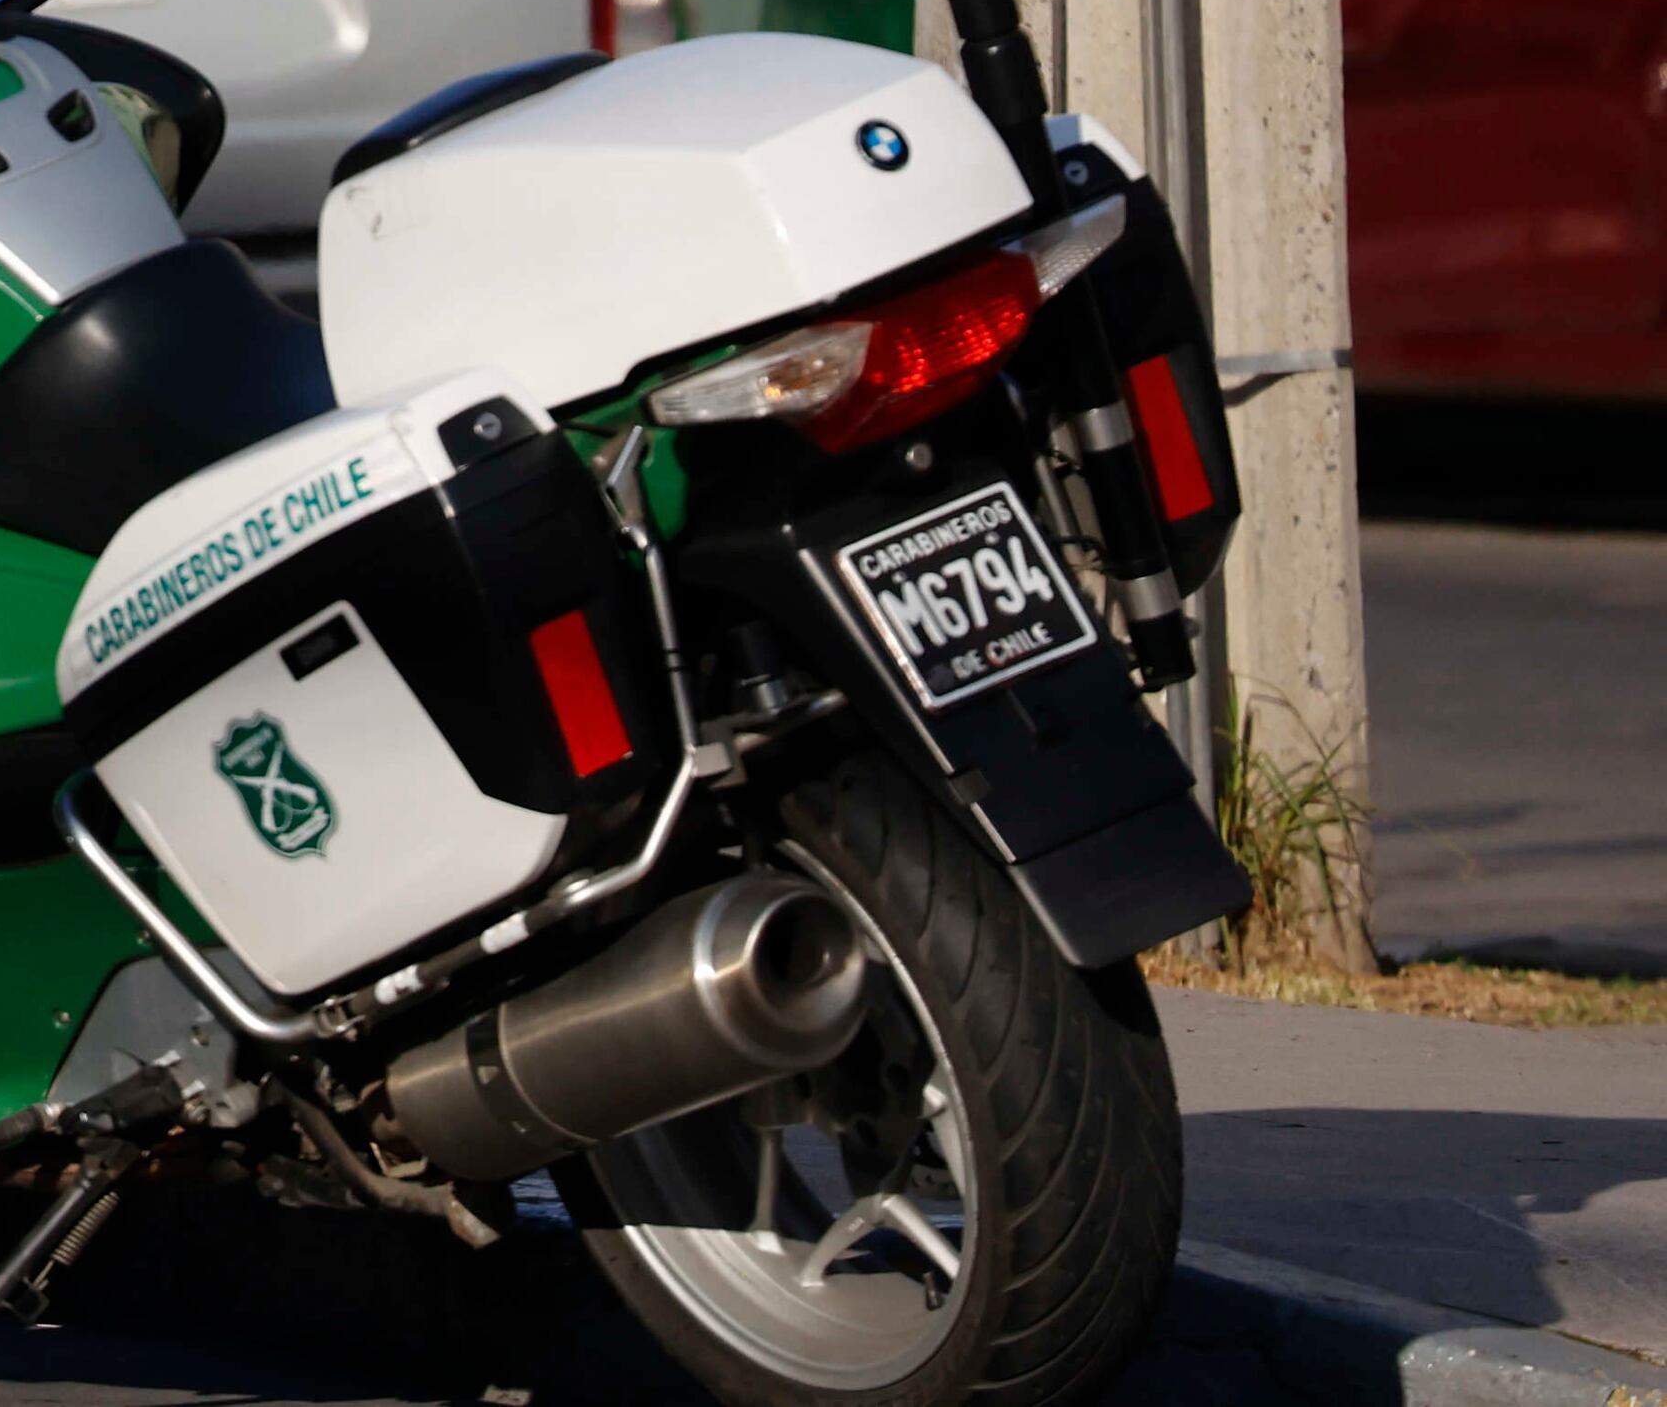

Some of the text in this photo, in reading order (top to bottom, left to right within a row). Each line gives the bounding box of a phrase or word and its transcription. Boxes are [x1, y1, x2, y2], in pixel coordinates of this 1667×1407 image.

[85, 456, 375, 664] CARABINEROS DE CHILE
[859, 499, 1013, 579] CARABINEROS
[877, 535, 1055, 657] M6794
[951, 621, 1053, 681] DE CHILE
